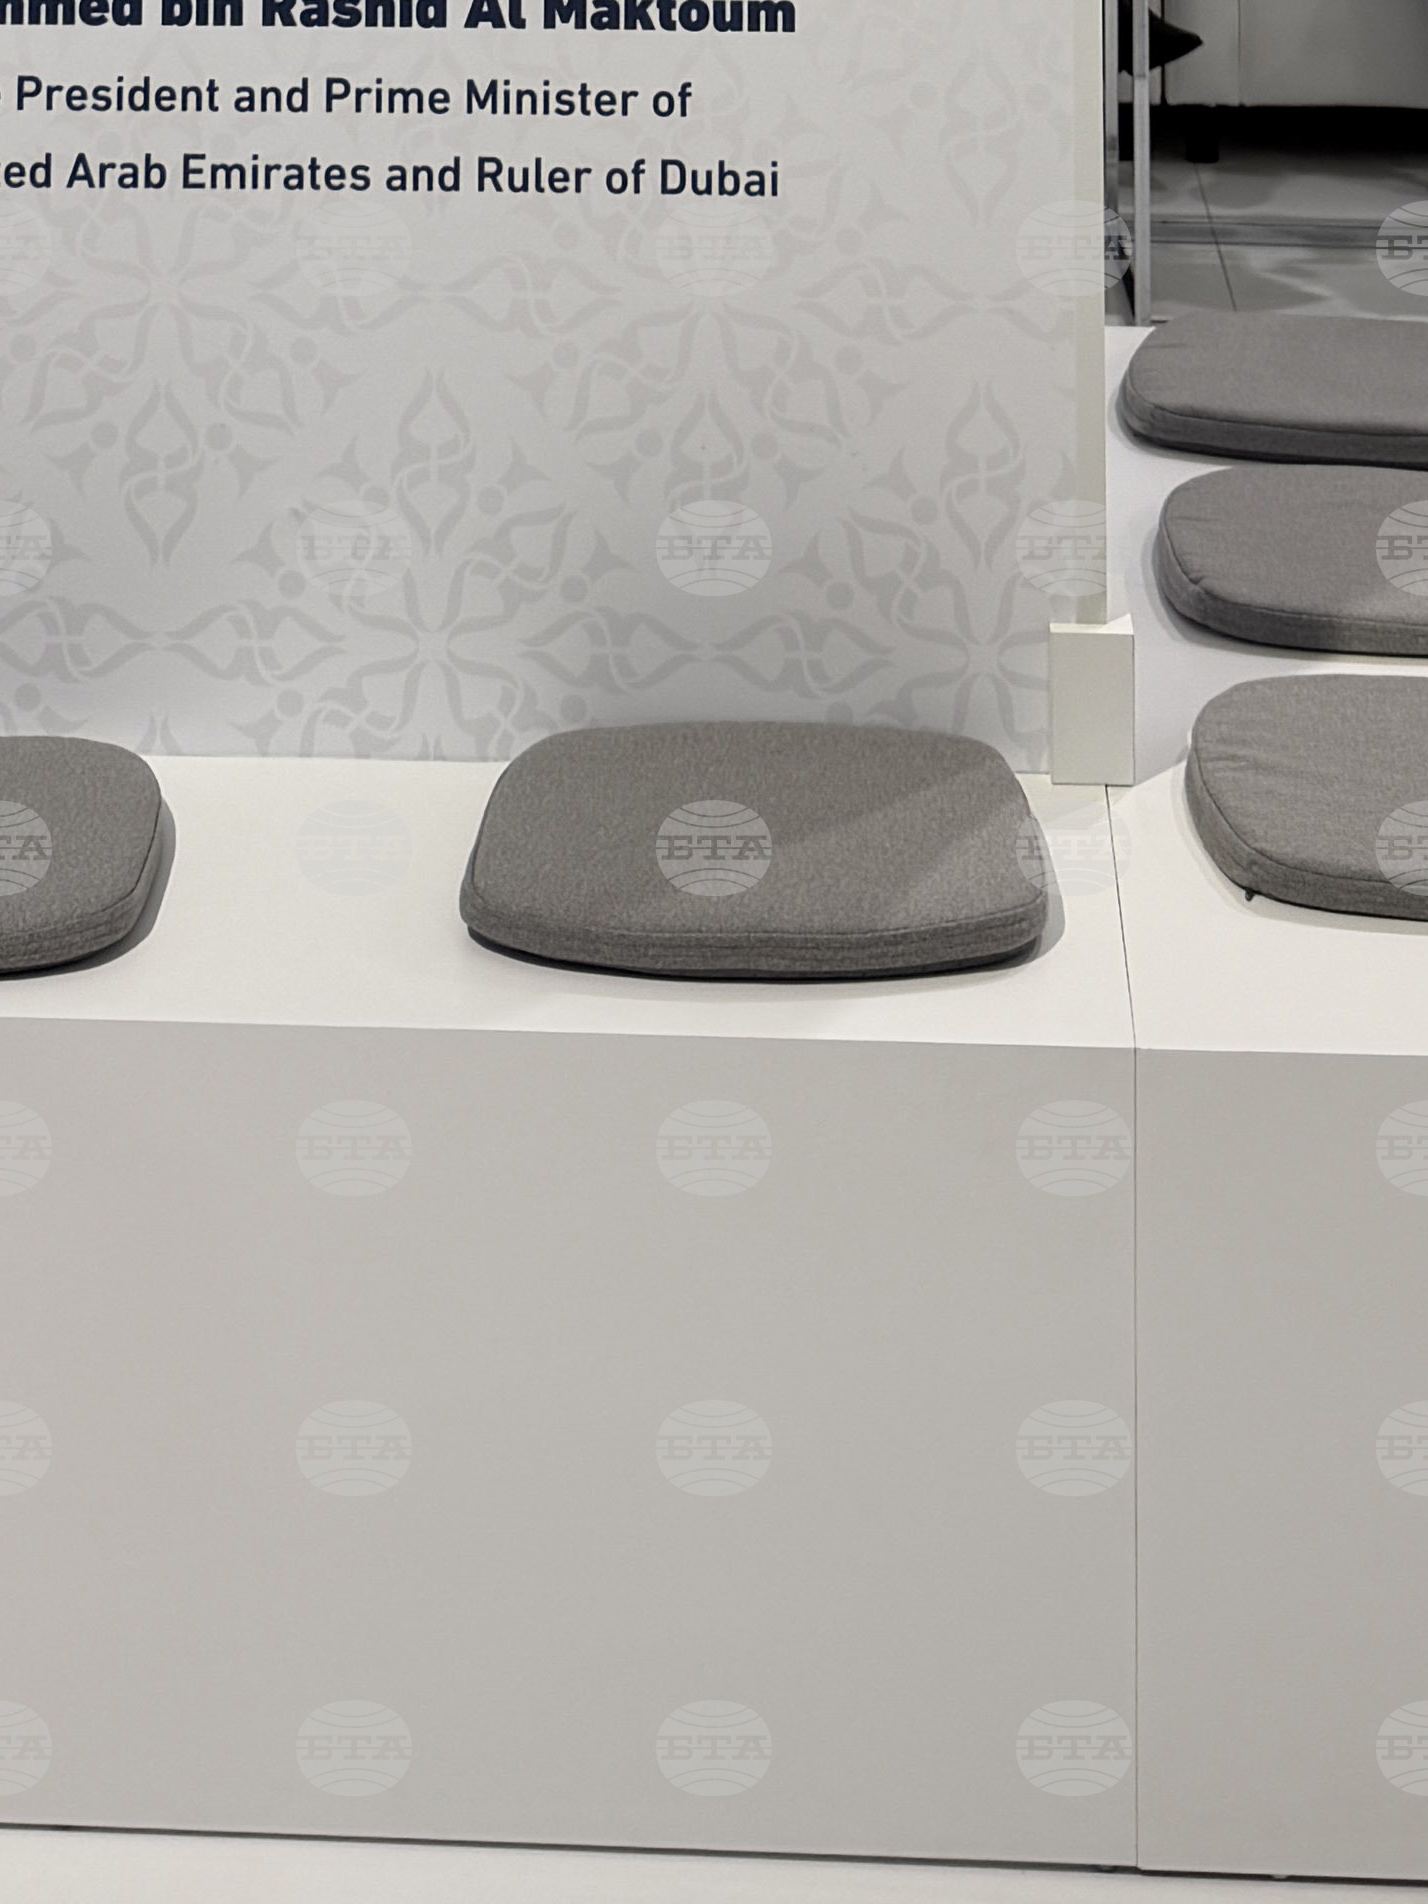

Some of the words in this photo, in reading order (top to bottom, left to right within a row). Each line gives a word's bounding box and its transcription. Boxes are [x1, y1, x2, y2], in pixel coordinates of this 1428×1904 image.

[17, 75, 219, 112] President
[234, 77, 308, 112] and
[326, 77, 450, 114] Prime
[467, 79, 638, 116] Minister
[653, 82, 692, 117] of
[67, 153, 166, 189] Arab
[183, 154, 370, 191] Emirates
[386, 156, 460, 192] and
[478, 157, 592, 193] Ruler
[606, 159, 645, 194] of
[661, 159, 777, 196] Dubai
